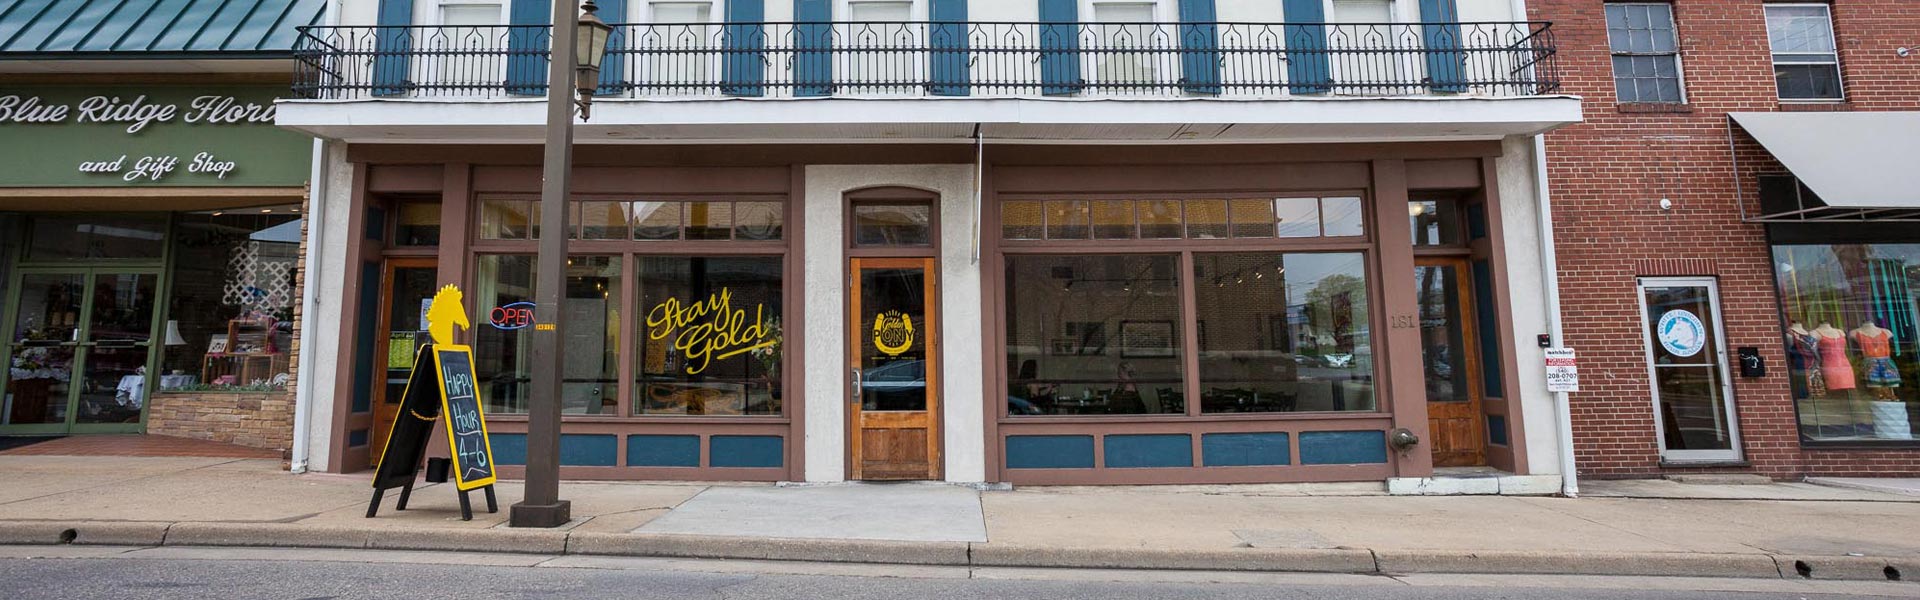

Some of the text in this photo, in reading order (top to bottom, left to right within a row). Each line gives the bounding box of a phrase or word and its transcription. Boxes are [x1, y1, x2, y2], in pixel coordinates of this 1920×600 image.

[0, 94, 276, 133] Blue Ridge Flori
[78, 151, 235, 181] and Gift Shop
[489, 307, 536, 325] OPEN
[646, 286, 732, 340] Stay
[1391, 315, 1415, 328] 181
[674, 303, 769, 375] Gold
[872, 328, 916, 342] PONY
[459, 437, 486, 467] 4-6
